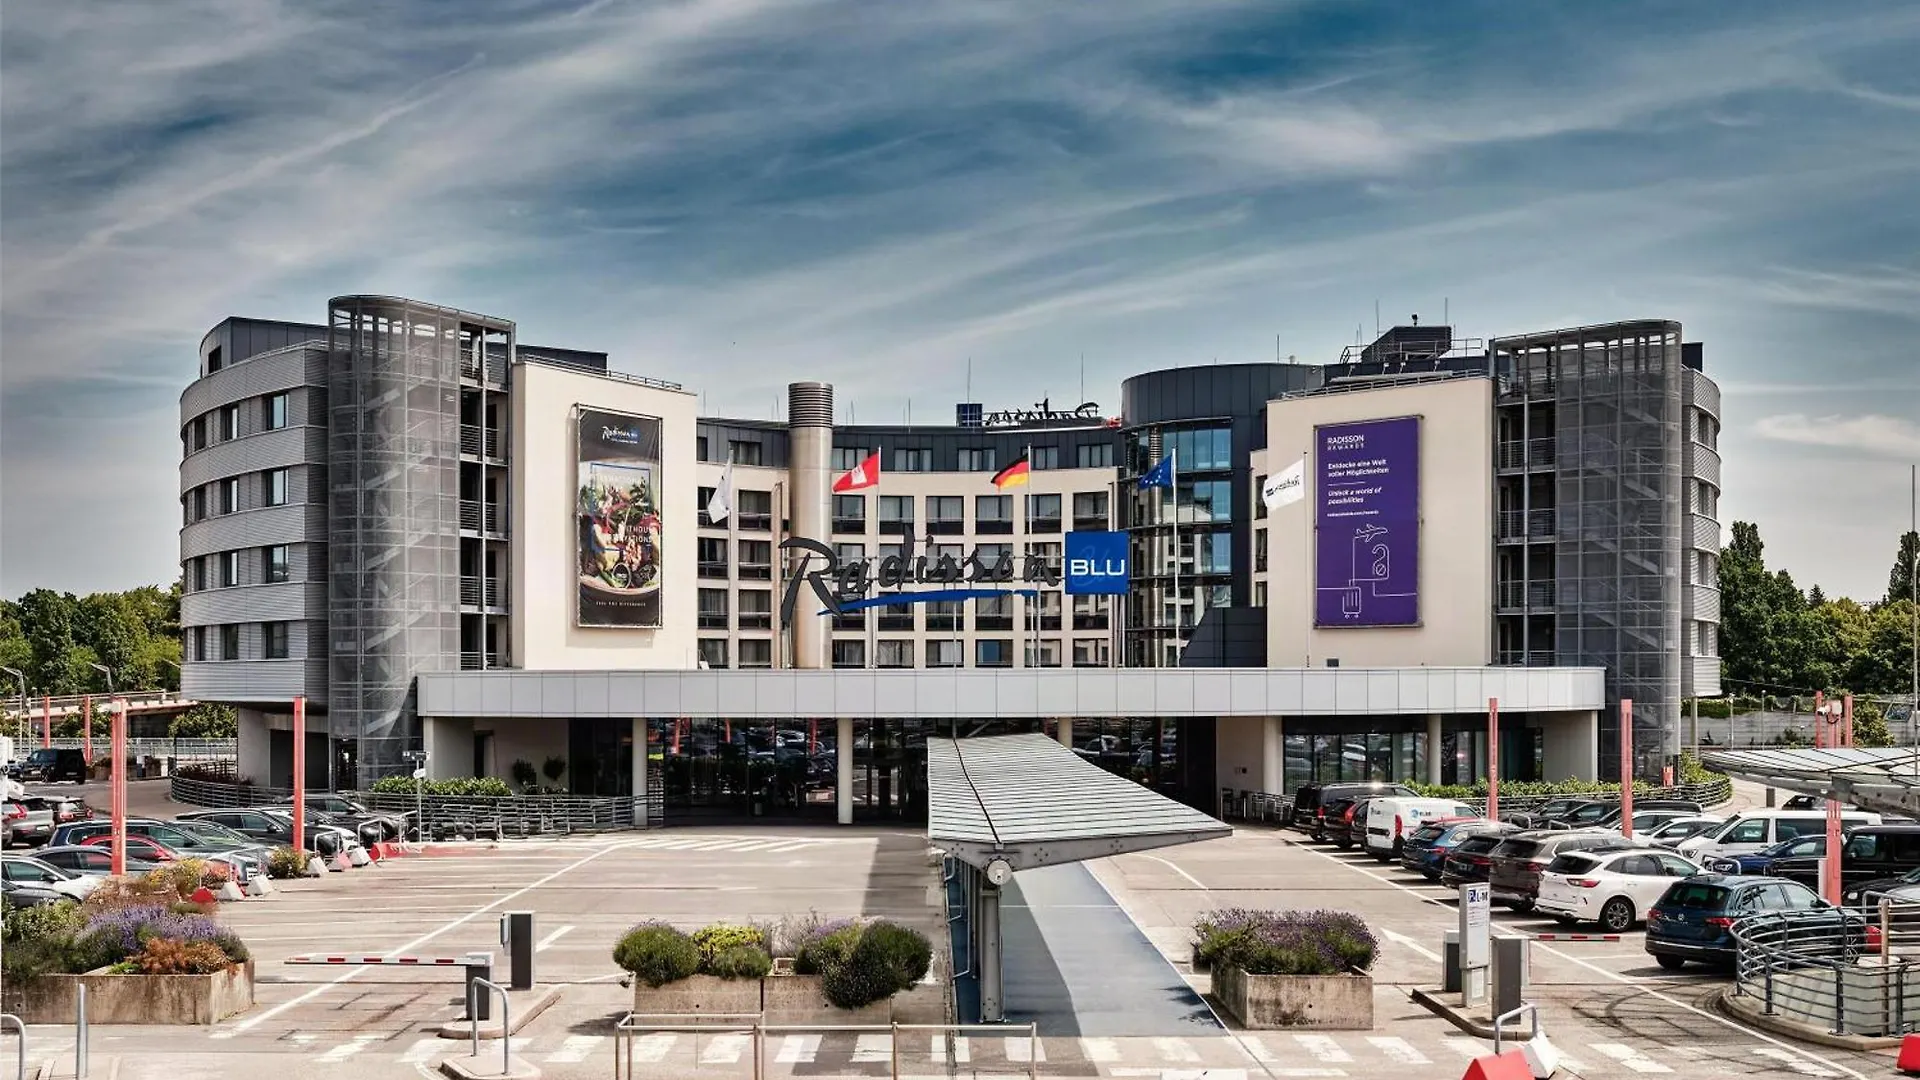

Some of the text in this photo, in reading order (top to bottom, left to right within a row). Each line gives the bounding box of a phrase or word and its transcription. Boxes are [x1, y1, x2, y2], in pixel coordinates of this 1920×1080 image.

[1327, 434, 1364, 444] RADISSON
[1328, 461, 1355, 470] Entdecke
[779, 524, 1126, 624] Radisson BLU
